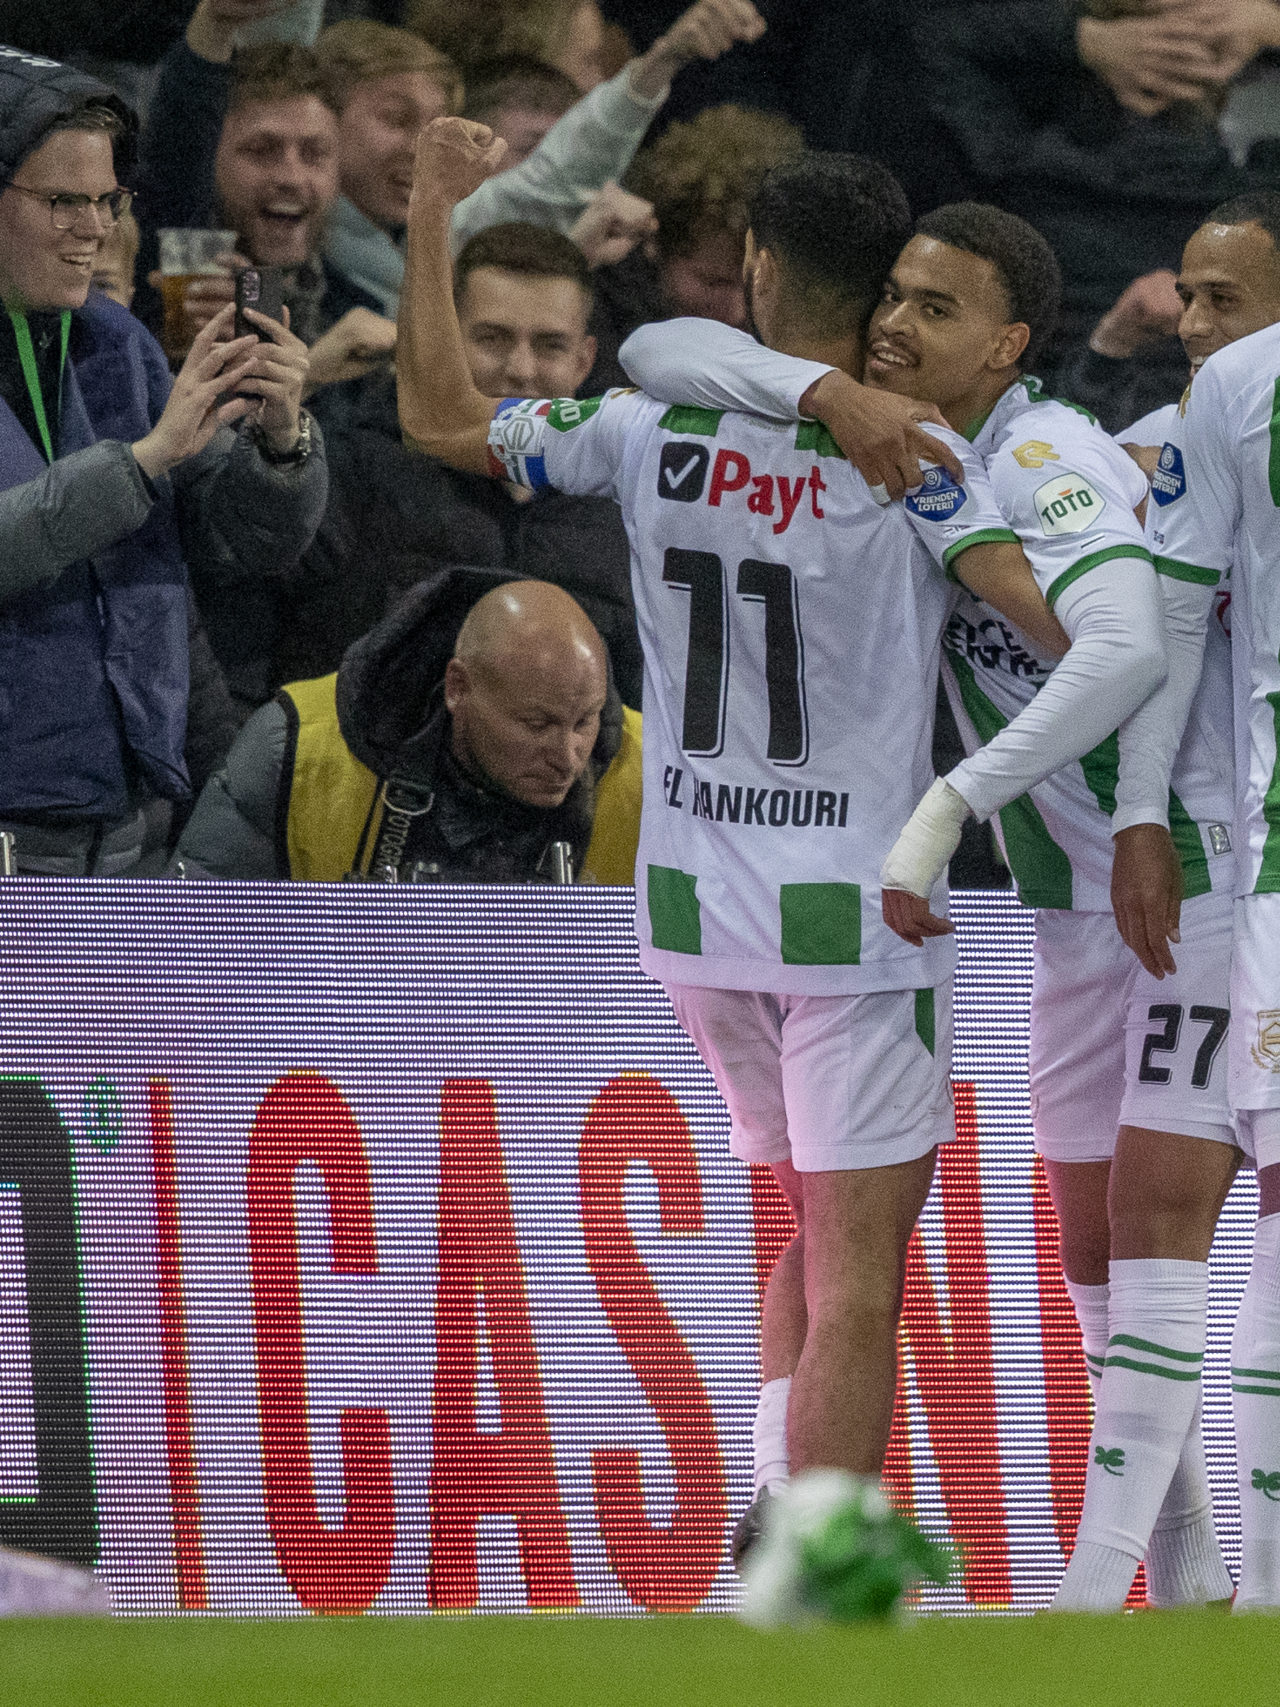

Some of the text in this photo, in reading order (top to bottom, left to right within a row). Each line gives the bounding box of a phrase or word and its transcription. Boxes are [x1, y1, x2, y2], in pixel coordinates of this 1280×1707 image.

[707, 448, 827, 535] Payt
[912, 490, 959, 505] VRIENDEN
[917, 500, 955, 513] LOTERIJ
[1041, 488, 1094, 527] TOTO
[661, 546, 810, 768] 11
[1138, 1003, 1232, 1090] 27
[246, 1069, 1097, 1615] CASN
